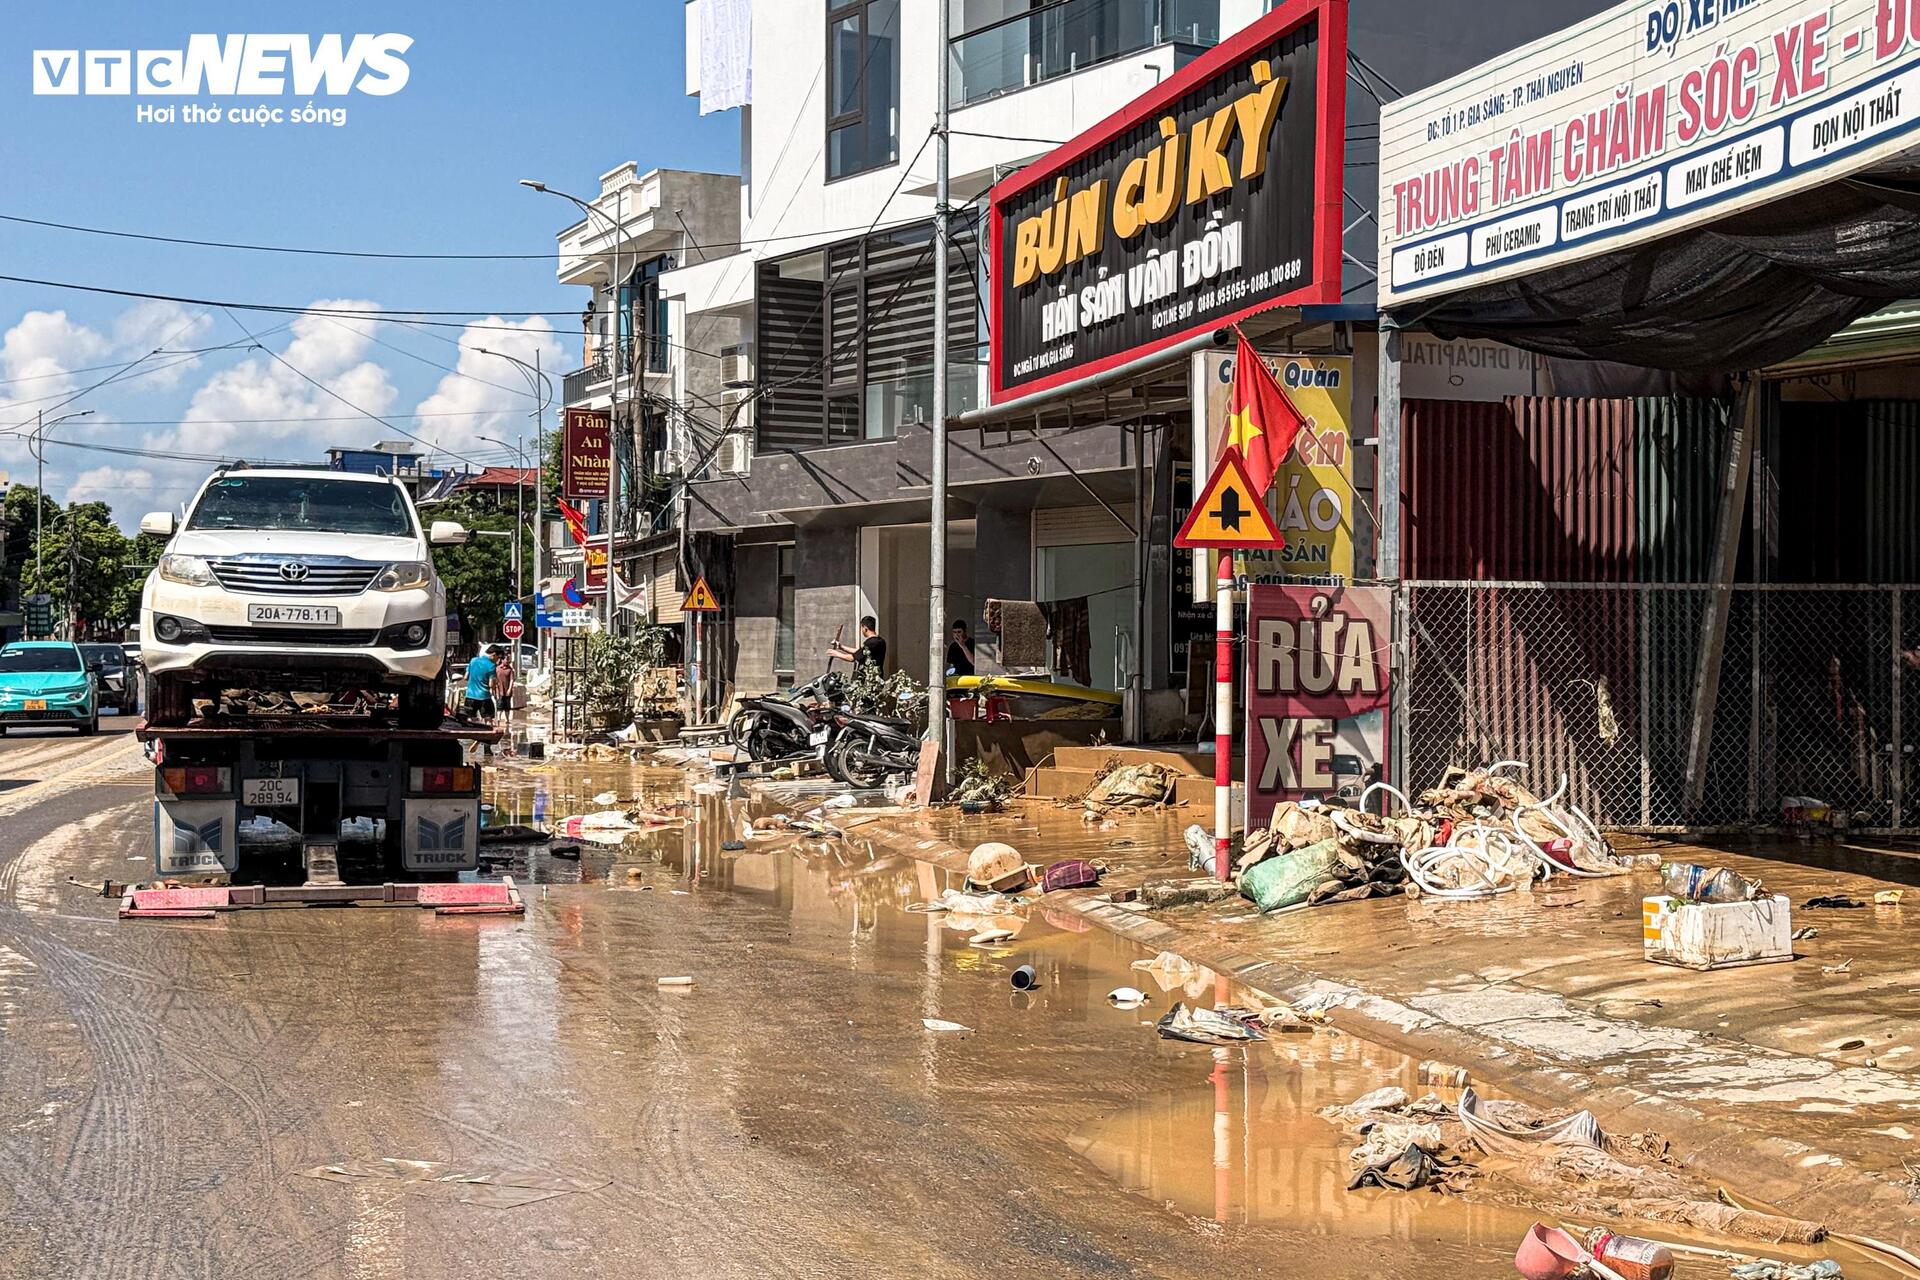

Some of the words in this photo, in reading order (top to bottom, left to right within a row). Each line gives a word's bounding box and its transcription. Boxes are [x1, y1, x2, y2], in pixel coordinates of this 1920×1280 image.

[1427, 119, 1440, 142] ĐC:
[1453, 113, 1457, 133] 1
[1459, 110, 1466, 131] P.
[1467, 104, 1481, 127] GIA
[1482, 94, 1505, 121] SÀNG
[1512, 87, 1524, 108] TP.
[1526, 73, 1545, 103] THÁI
[1547, 60, 1584, 95] NGUYÊN
[1392, 156, 1479, 237] TRUNG
[1489, 127, 1552, 206] TÂM
[1563, 84, 1668, 183] CHĂM
[1677, 43, 1757, 142] SÓC
[1770, 13, 1828, 107] XE
[1813, 119, 1839, 152] DỌN
[1842, 103, 1865, 141] NỘI
[1869, 81, 1902, 126] THẤT
[1013, 175, 1109, 288] BÚN
[1113, 116, 1188, 240] CÙ
[1186, 59, 1289, 206] KỲ
[1685, 165, 1708, 195] MAY
[1711, 147, 1733, 185] GHẾ
[1736, 143, 1762, 180] NỆM
[1565, 205, 1595, 233] TRANG
[1597, 194, 1611, 223] TRÍ
[1614, 189, 1632, 223] NỘI
[1633, 176, 1659, 212] THẤT
[1485, 226, 1502, 258] PHỦ
[1503, 222, 1542, 252] CERAMIC
[1414, 251, 1426, 276] ĐỘ
[1427, 245, 1444, 269] ĐÈN
[1042, 285, 1078, 343] HẢI
[1080, 266, 1125, 328] SẢN
[1128, 248, 1178, 308] VÂN
[1182, 210, 1243, 289] ĐỒN
[1152, 306, 1178, 330] HOTLINE
[1178, 300, 1194, 321] SHIP
[1284, 360, 1340, 389] Quán
[575, 415, 609, 428] Tâm
[581, 436, 602, 449] An
[572, 454, 611, 469] Nhàn
[1281, 538, 1327, 562] SẢN
[256, 607, 329, 621] 20A-778.11
[505, 625, 522, 633] STOP
[1257, 595, 1377, 693] RỬA
[1258, 718, 1334, 789] XE
[249, 792, 293, 804] 289.94
[259, 780, 283, 792] 20C
[169, 854, 225, 867] TRUCK
[414, 852, 467, 864] TRUCK
